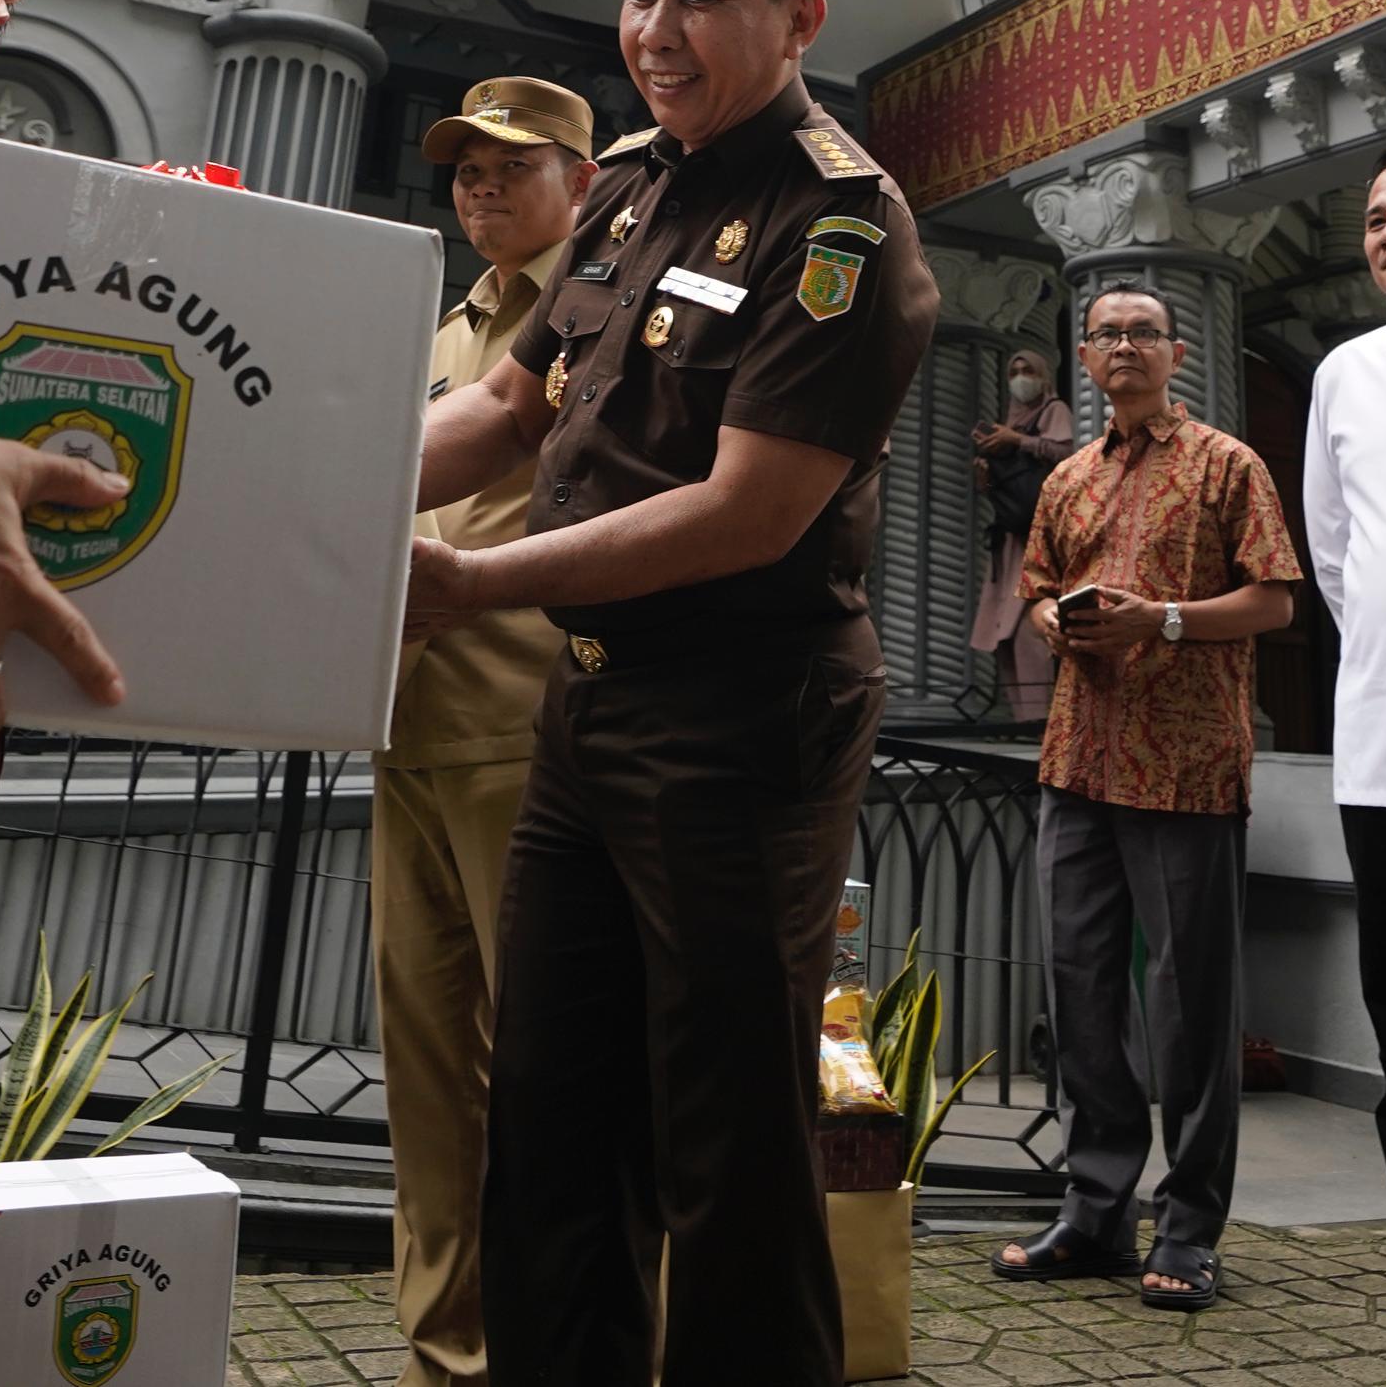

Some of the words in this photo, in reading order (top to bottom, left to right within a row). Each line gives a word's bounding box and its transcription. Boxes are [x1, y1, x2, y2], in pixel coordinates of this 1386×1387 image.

[95, 261, 272, 408] AGUNG
[97, 386, 170, 426] SELATAN
[28, 536, 67, 564] SATU
[25, 1249, 91, 1307] GRIYA
[98, 1244, 171, 1292] AGUNG
